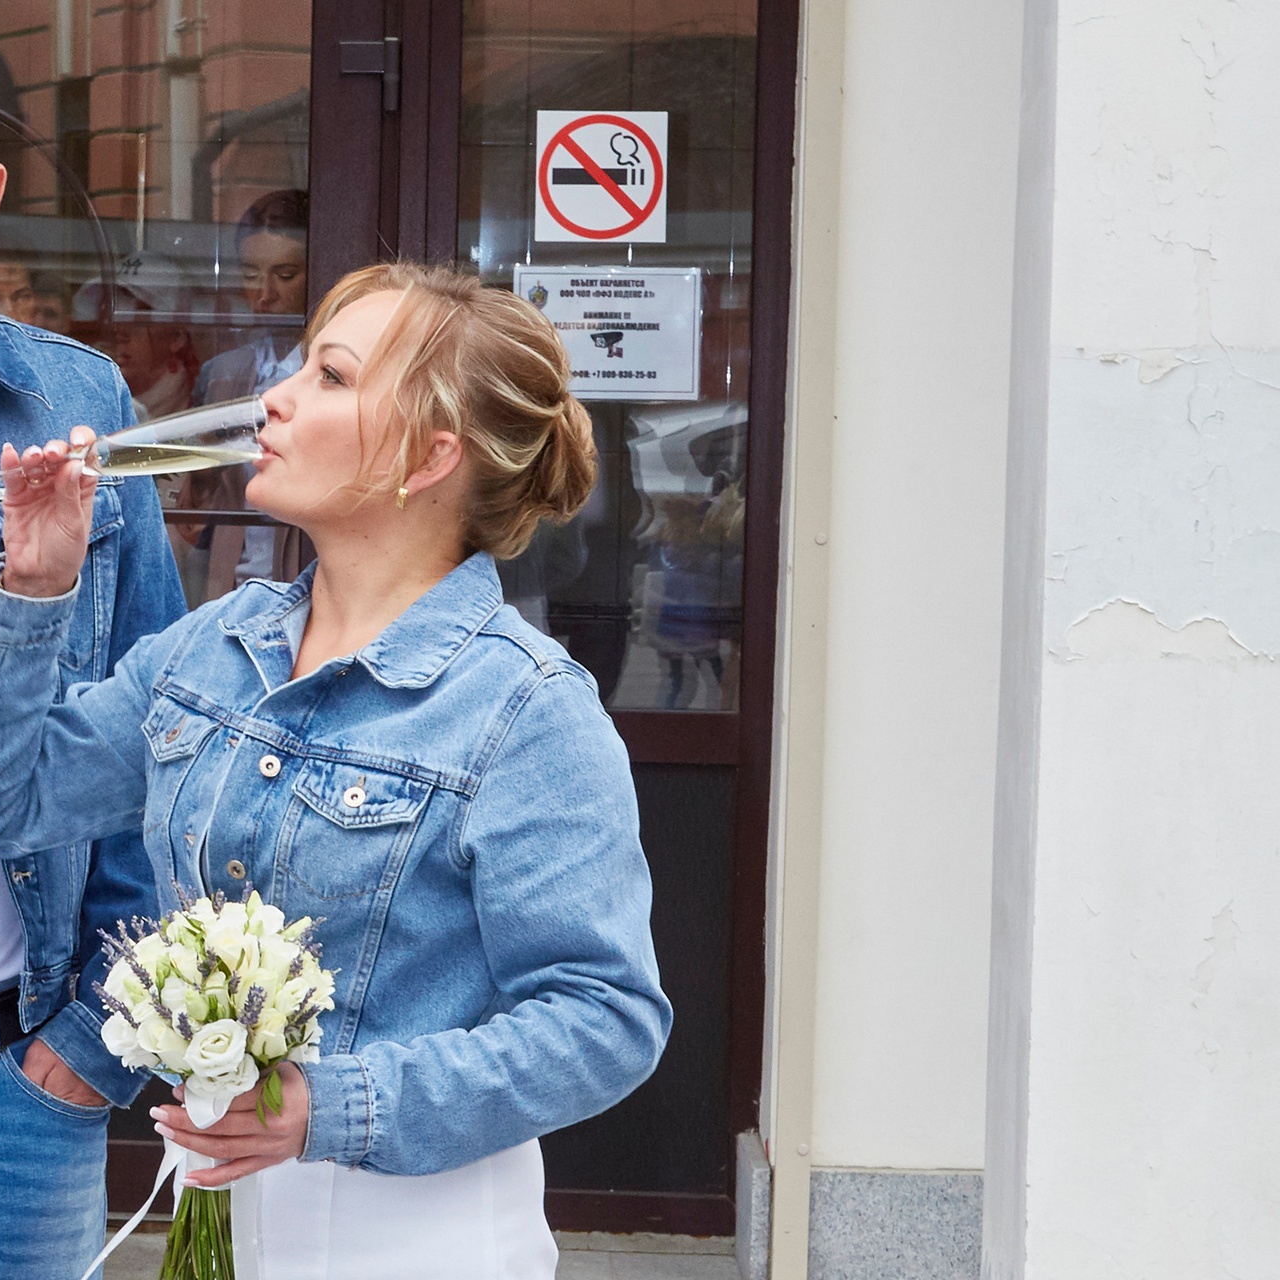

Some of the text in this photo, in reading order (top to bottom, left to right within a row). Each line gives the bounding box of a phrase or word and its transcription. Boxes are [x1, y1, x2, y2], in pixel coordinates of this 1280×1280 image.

[570, 279, 645, 287] ОБЪЕКТ ОХРАНЯЕТСЯ
[560, 290, 574, 298] ООО
[576, 290, 591, 298] ЧОП
[583, 311, 622, 320] ВНИМАНИЕ
